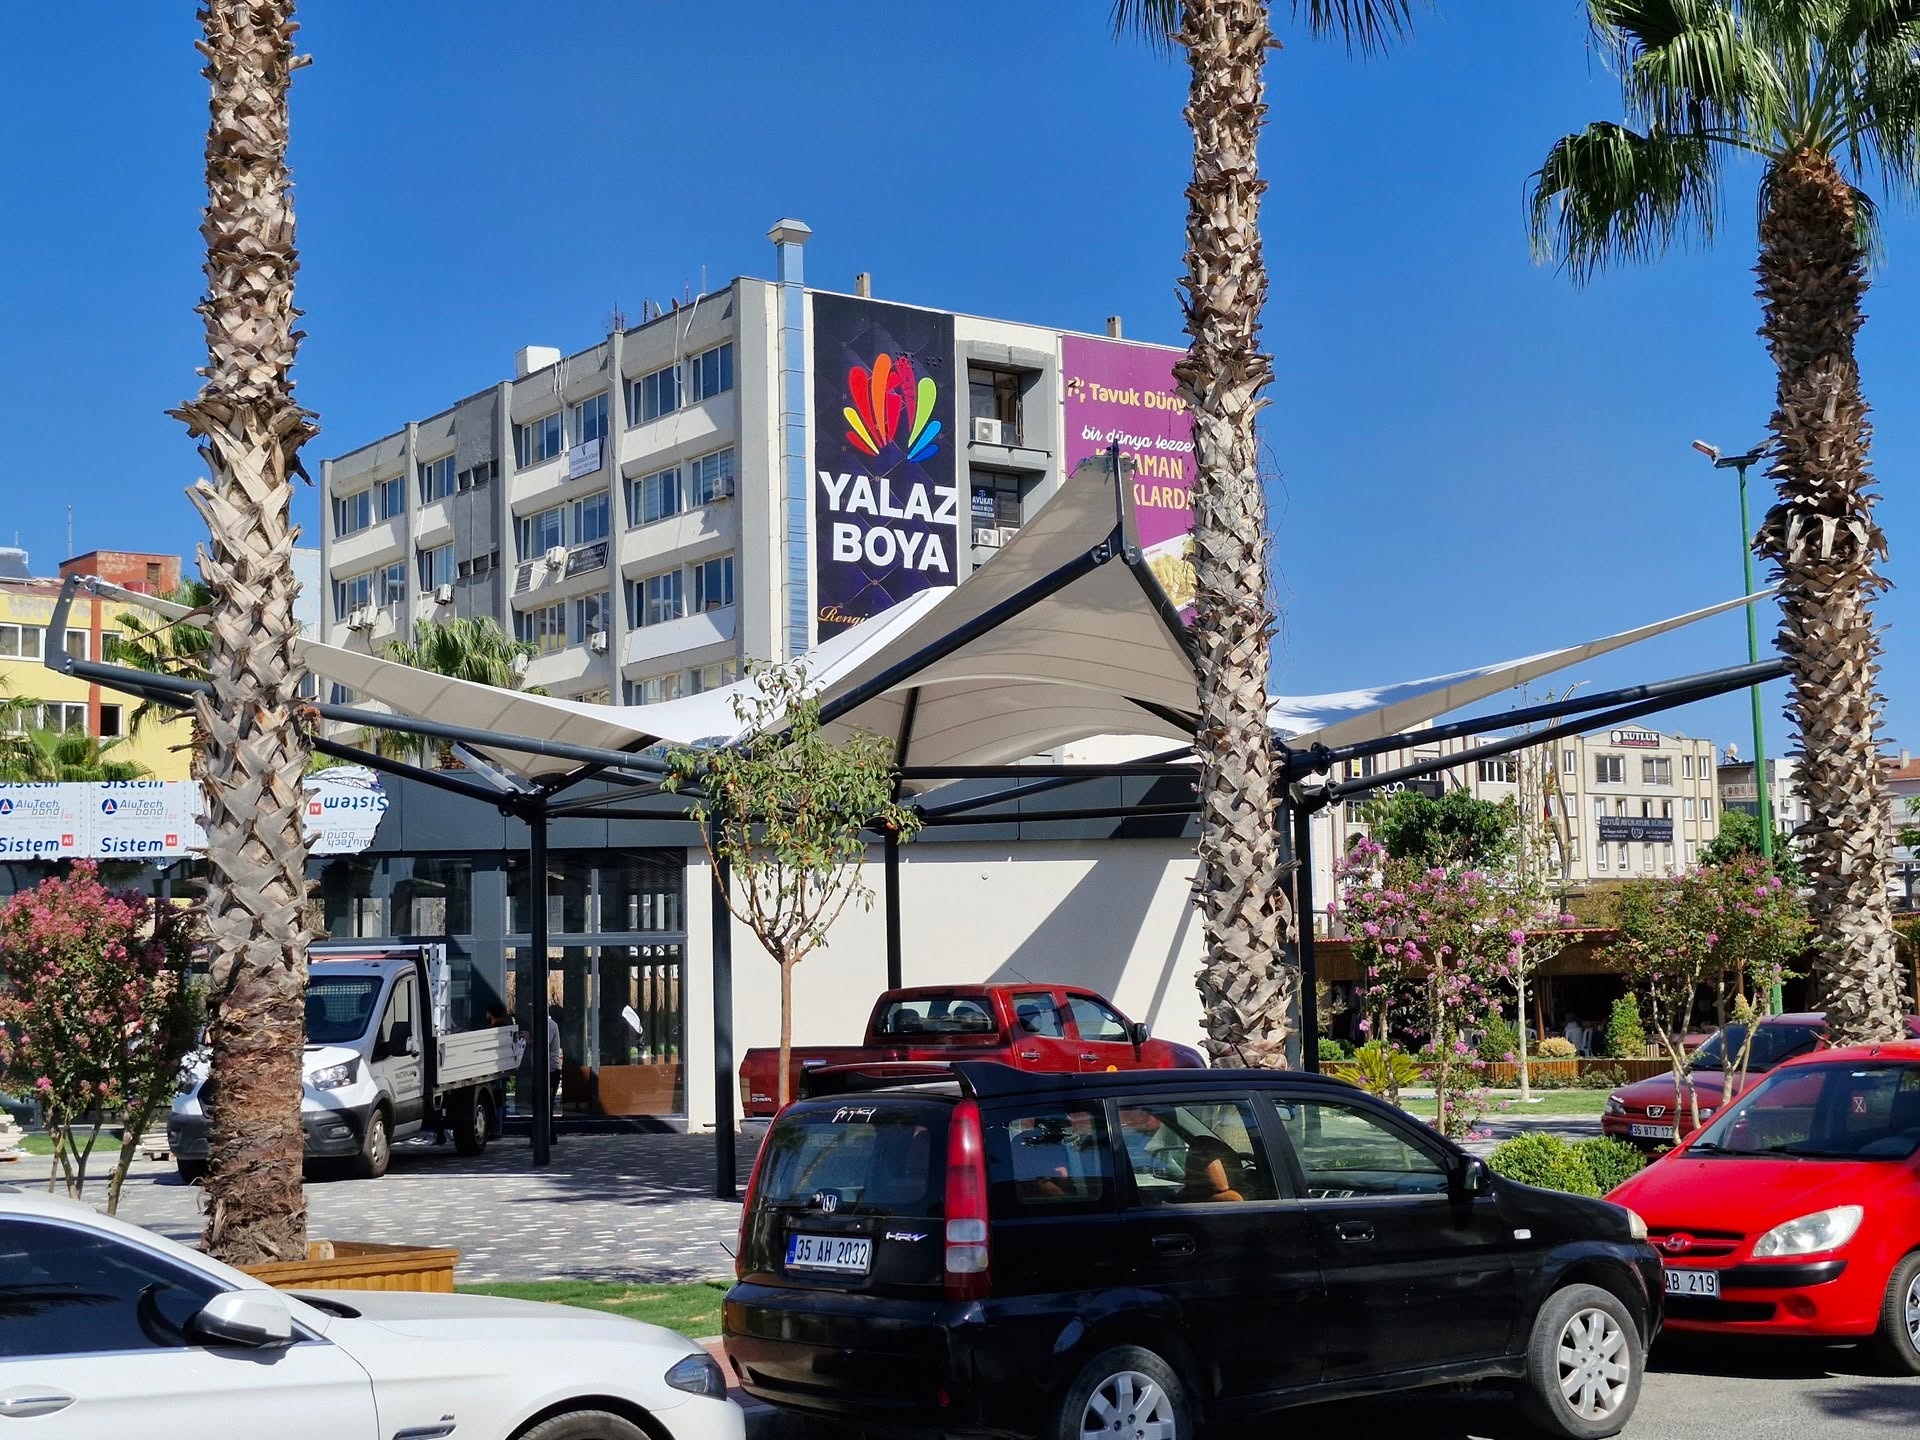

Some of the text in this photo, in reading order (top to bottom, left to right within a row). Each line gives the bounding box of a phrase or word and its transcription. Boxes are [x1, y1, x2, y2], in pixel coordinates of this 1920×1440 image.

[1089, 383, 1188, 415] Tavuk Düny
[1082, 425, 1196, 453] bir dünya lezze
[818, 471, 958, 526] YALAZ
[832, 522, 950, 573] BOYA
[1622, 731, 1659, 741] KUTLUK
[15, 799, 61, 809] AluTech
[119, 799, 164, 809] AluTech
[323, 796, 387, 812] Sistem
[31, 807, 61, 816] bond
[135, 807, 164, 816] bond
[0, 838, 60, 852] Sistem
[101, 838, 163, 852] Sistem
[1632, 1125, 1642, 1135] 35
[797, 1239, 868, 1265] 35 AH 2032
[1664, 1272, 1715, 1292] AB 219
